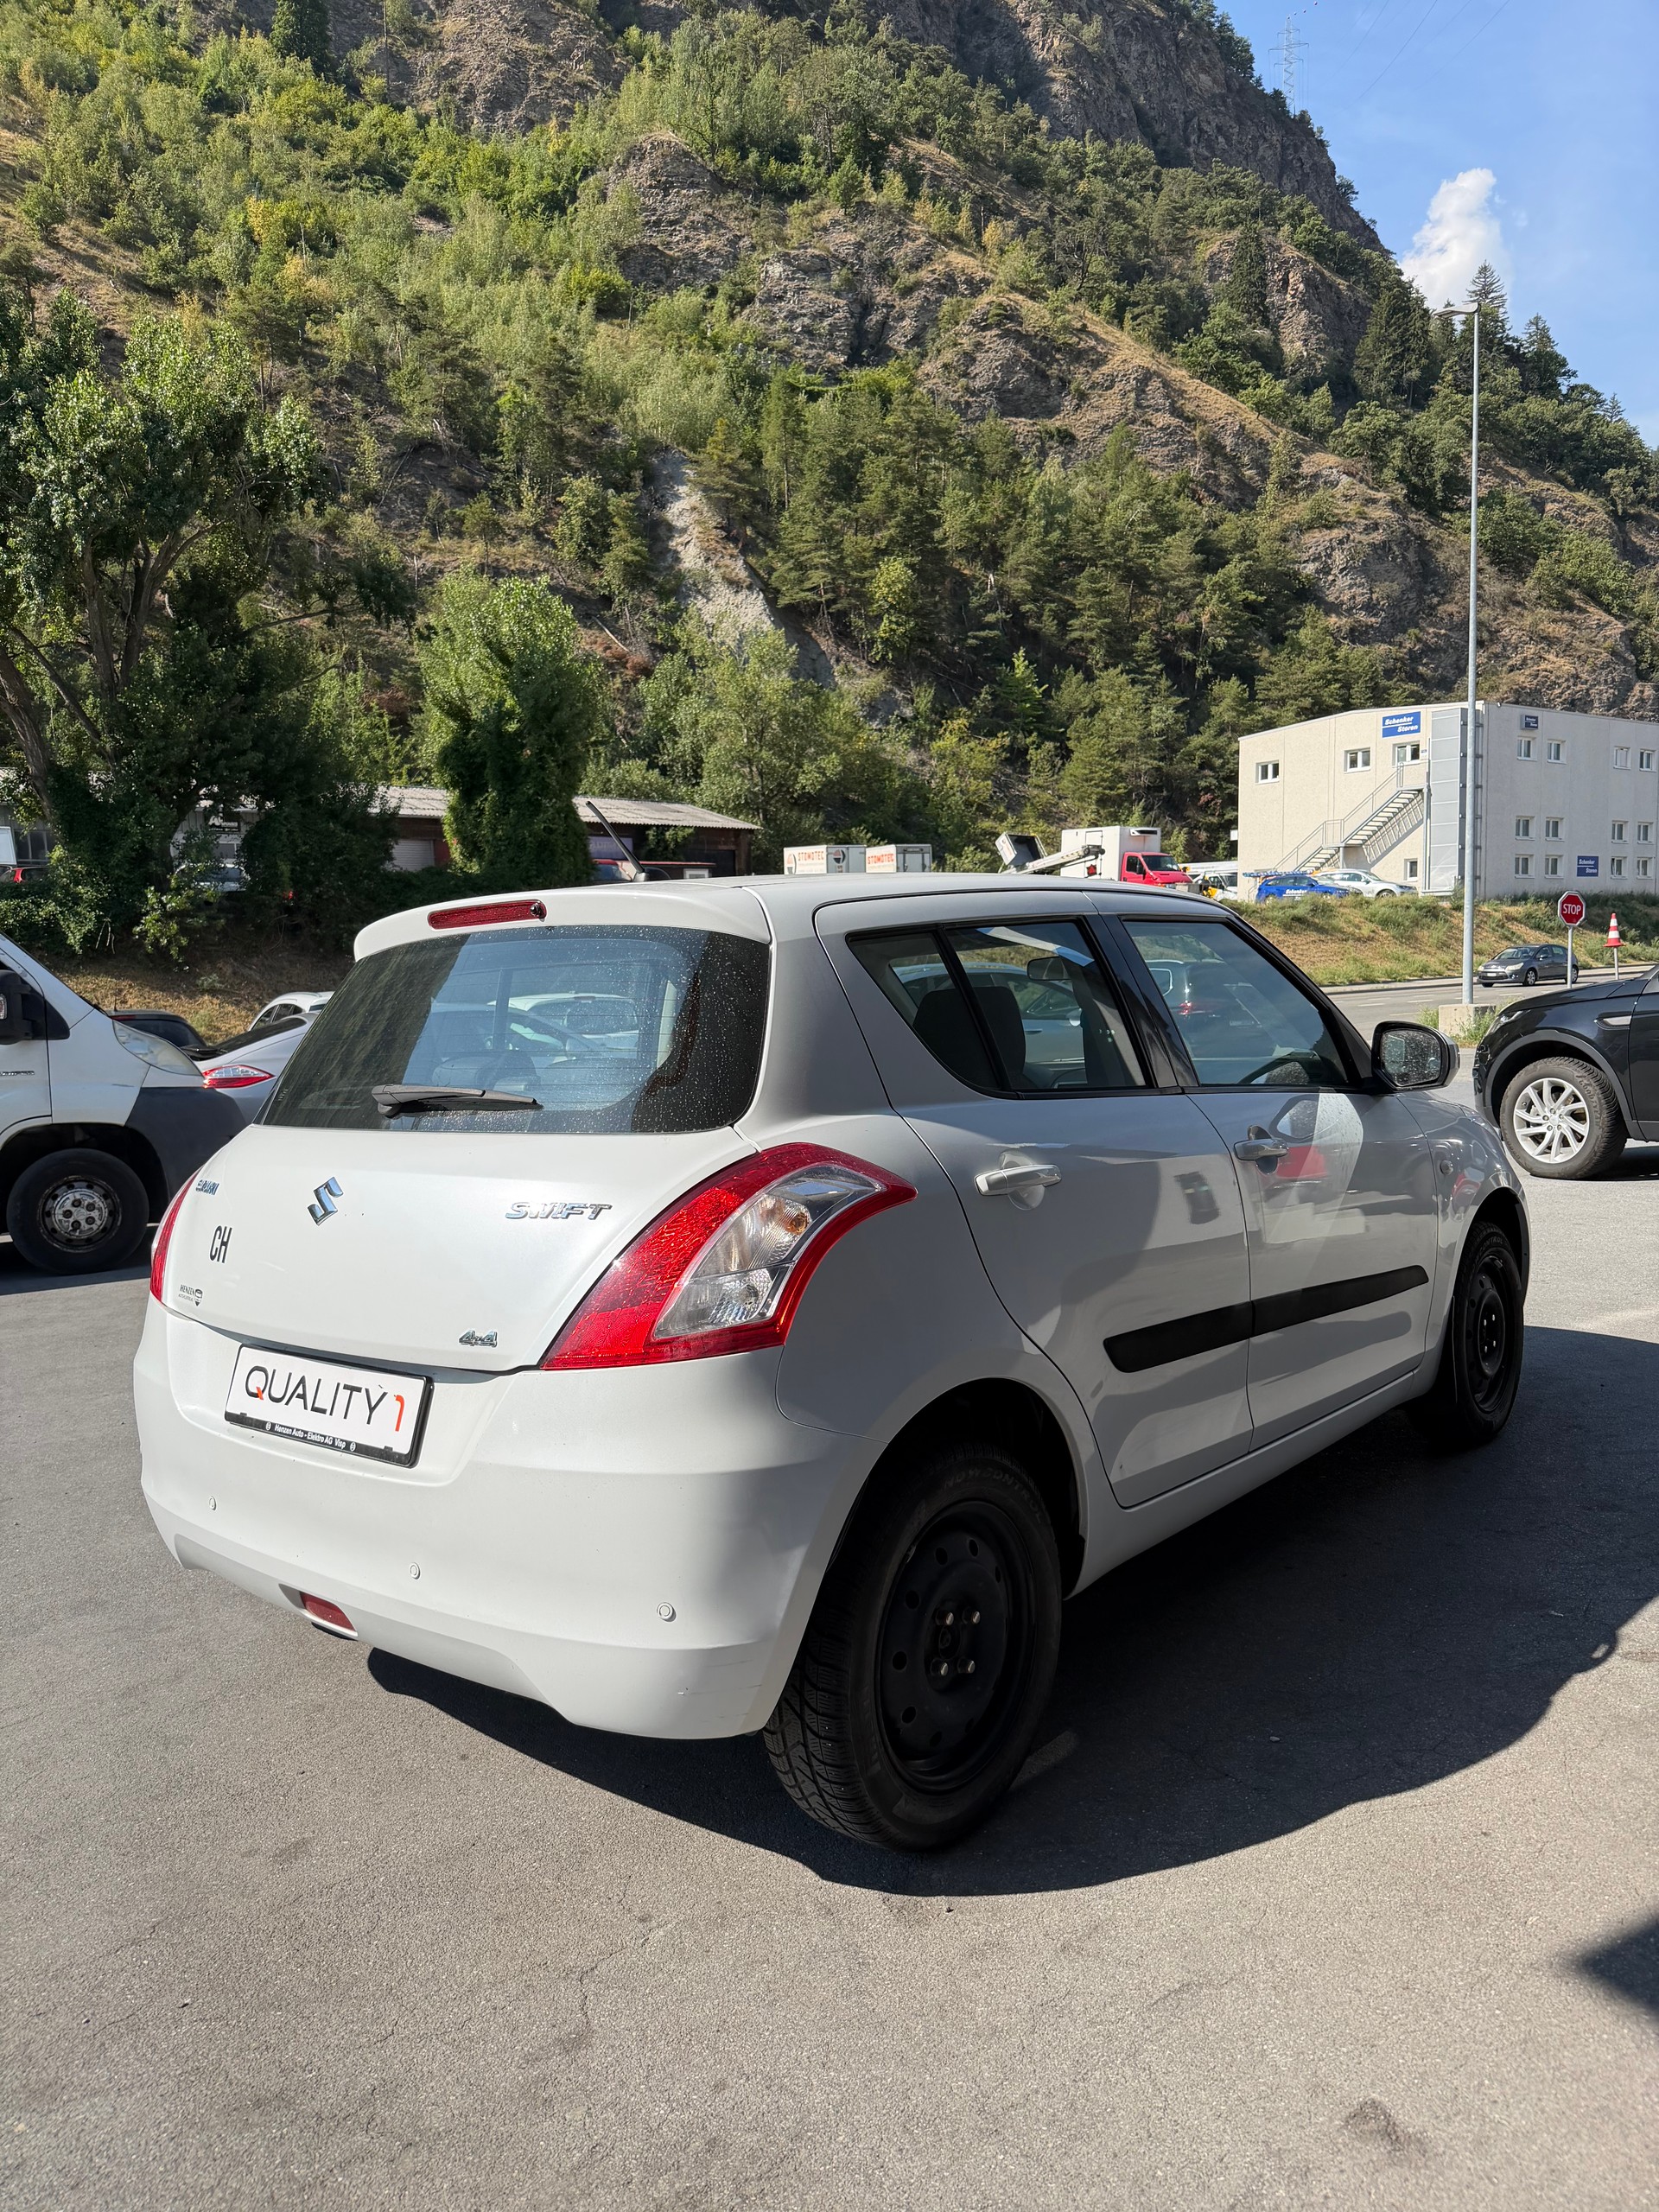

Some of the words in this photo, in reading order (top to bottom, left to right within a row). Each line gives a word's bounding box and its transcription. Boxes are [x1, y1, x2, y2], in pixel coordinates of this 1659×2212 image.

[1384, 716, 1414, 725] Schenker
[1562, 903, 1582, 915] STOP
[505, 1202, 613, 1220] SWIFT
[209, 1225, 232, 1263] CH
[274, 1423, 292, 1434] Henzen
[292, 1428, 304, 1438] Auto
[307, 1431, 325, 1442] Elektro
[324, 1435, 334, 1445] AG
[334, 1438, 346, 1450] Visp
